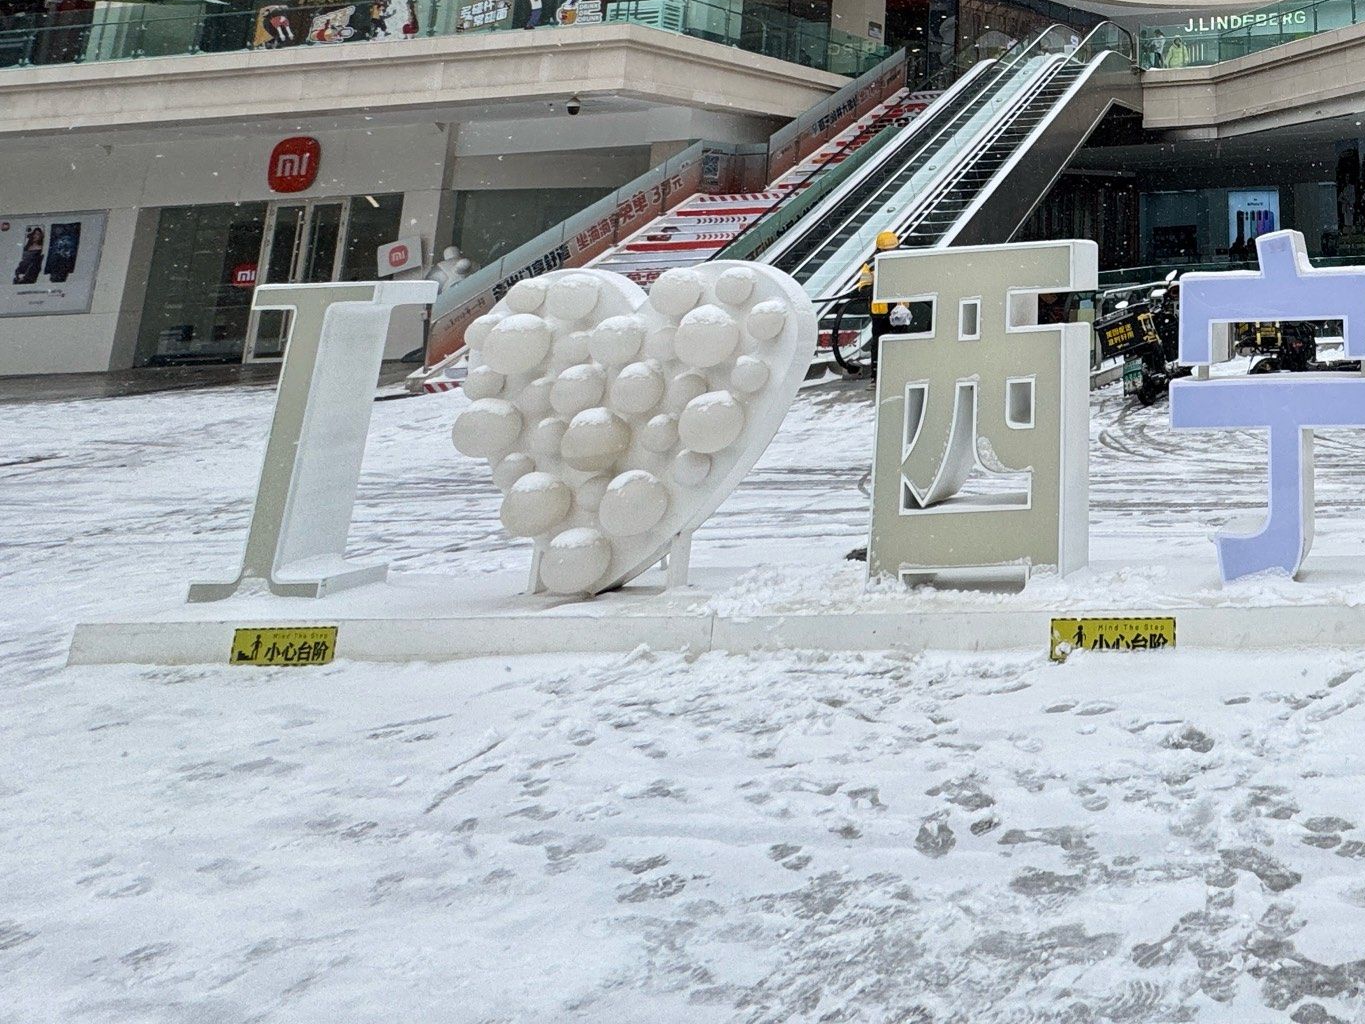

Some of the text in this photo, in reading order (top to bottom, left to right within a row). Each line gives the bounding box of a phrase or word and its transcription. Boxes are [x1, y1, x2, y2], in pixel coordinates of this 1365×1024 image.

[1097, 624, 1119, 632] Mind
[1144, 624, 1165, 632] Step
[264, 640, 329, 662] 小心台阶
